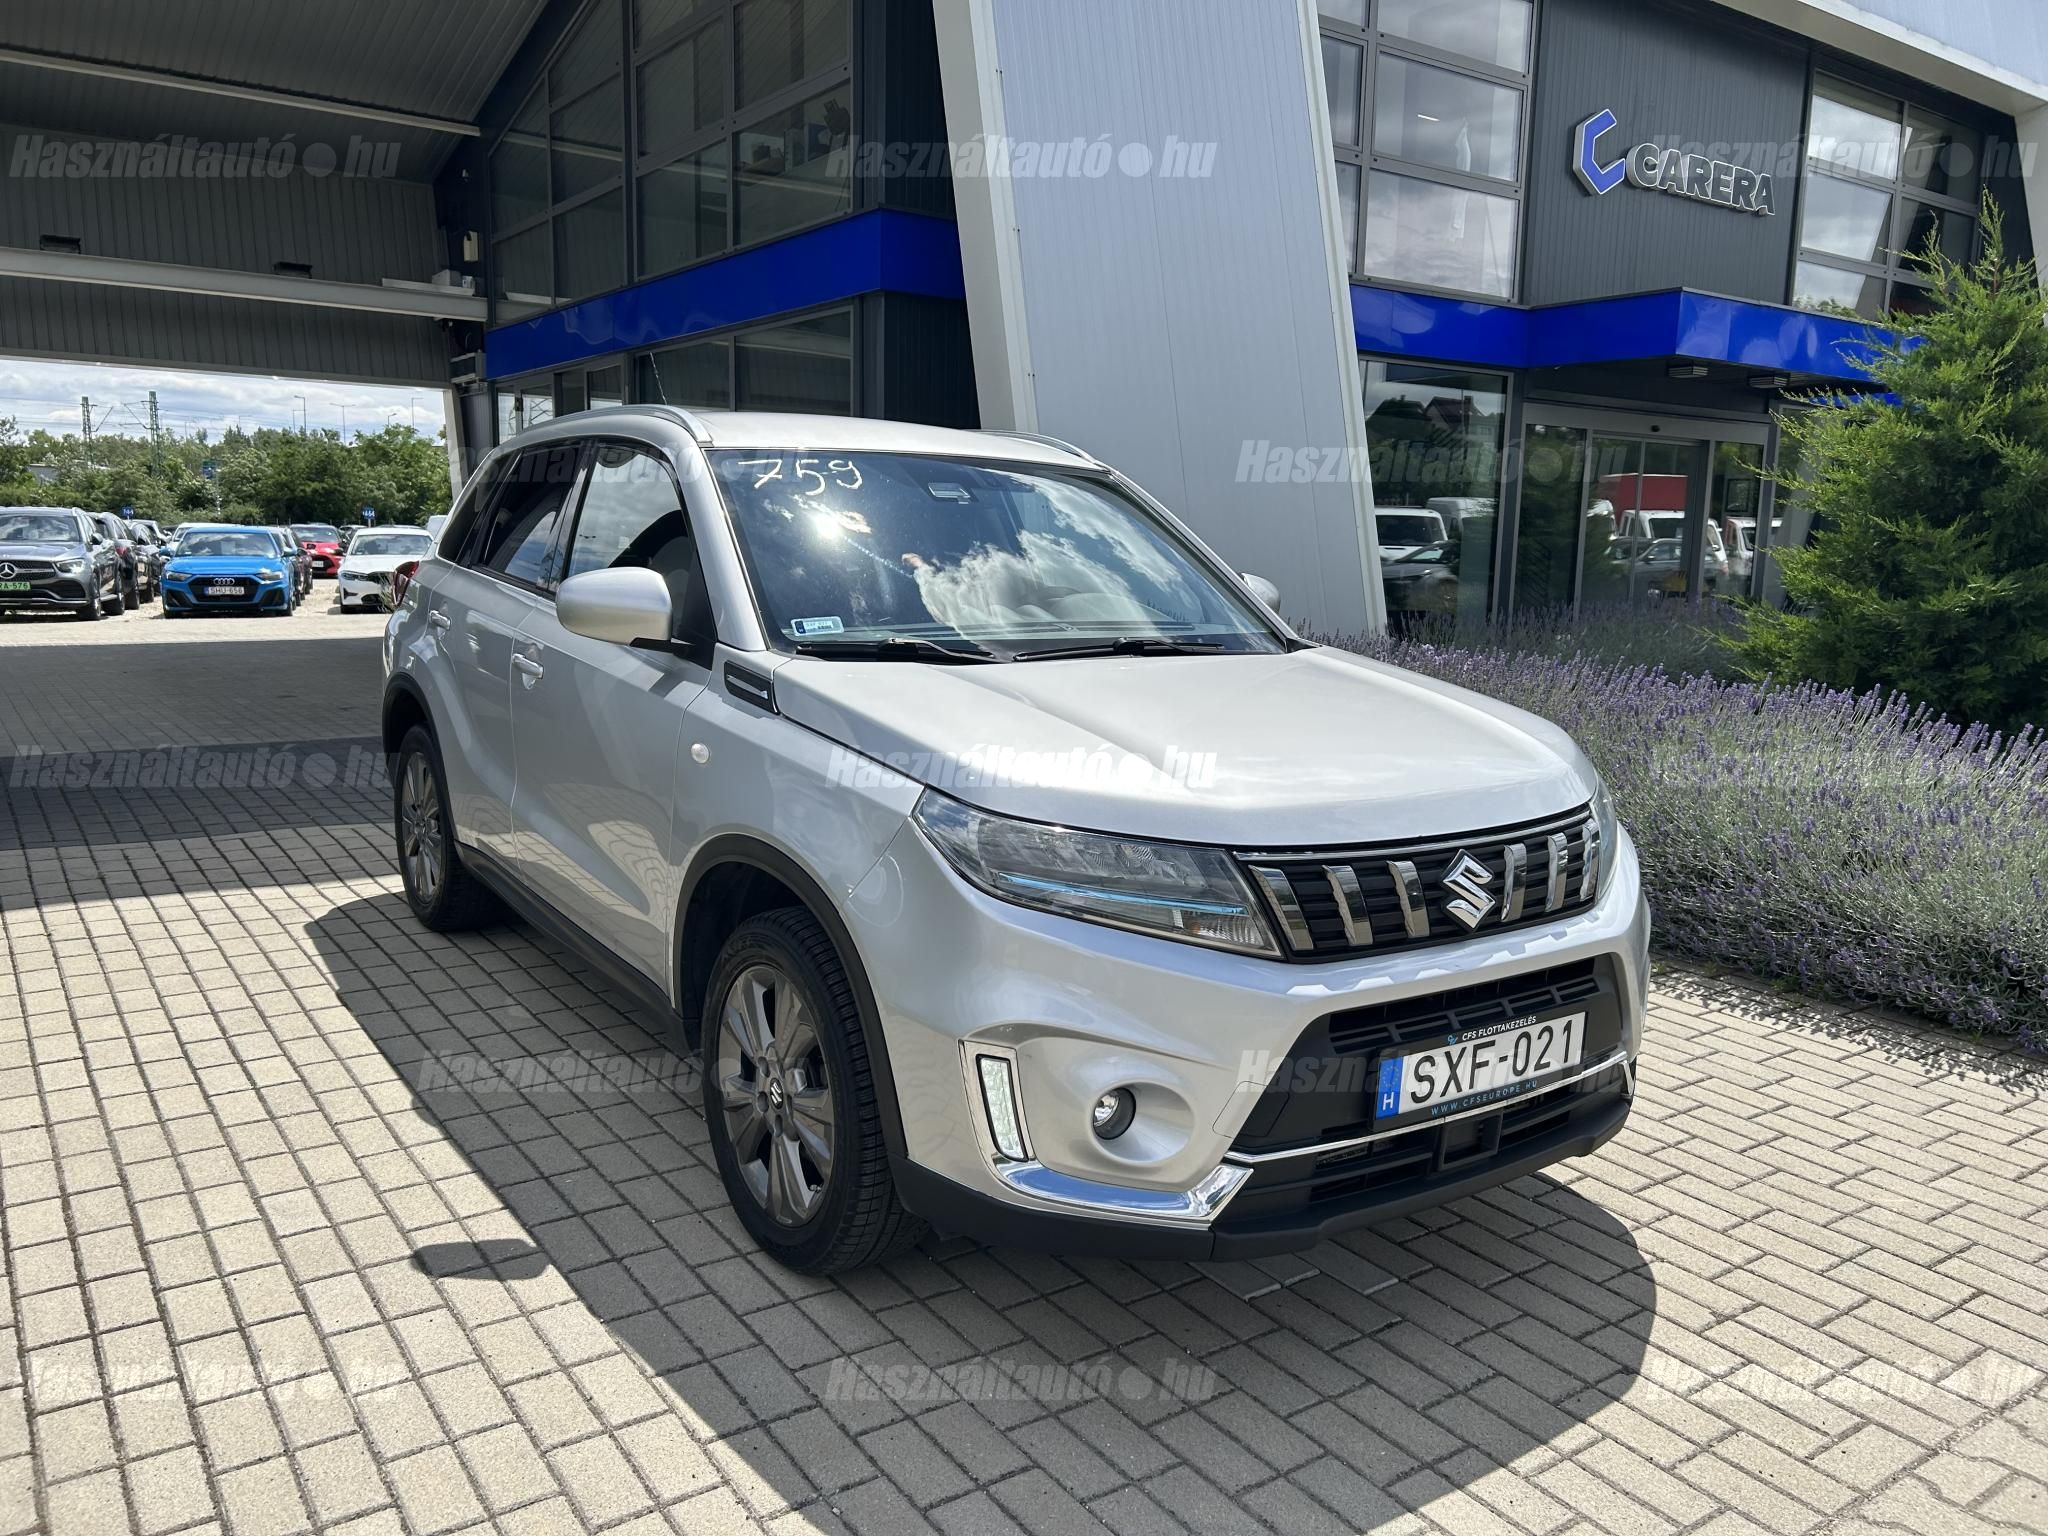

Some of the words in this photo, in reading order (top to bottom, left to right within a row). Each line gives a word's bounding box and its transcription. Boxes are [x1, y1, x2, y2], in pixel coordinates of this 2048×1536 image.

[1626, 143, 1775, 215] CARERA
[738, 459, 863, 496] 759
[1461, 1030, 1477, 1042] CFS
[1478, 1015, 1537, 1038] FLOTTAKEZELÉS
[1382, 1091, 1395, 1111] H
[1410, 1019, 1574, 1104] SXF-021
[1431, 1080, 1539, 1117] WWW.CFSEUROPE.HU
